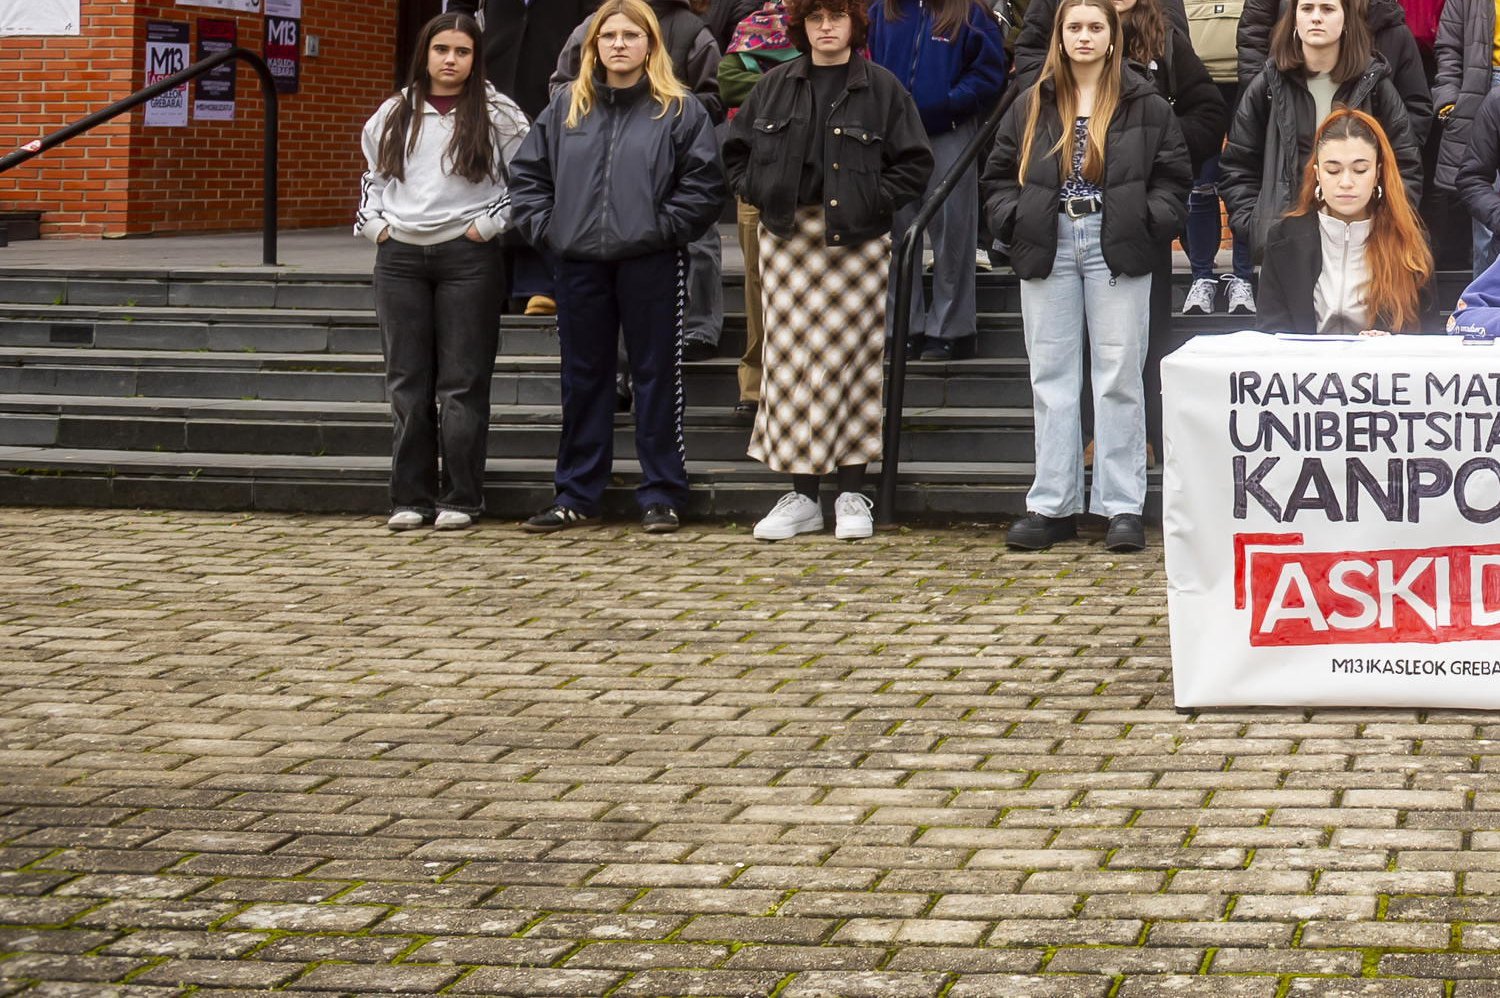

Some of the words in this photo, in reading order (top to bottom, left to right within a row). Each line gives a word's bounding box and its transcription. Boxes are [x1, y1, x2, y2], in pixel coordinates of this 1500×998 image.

[268, 18, 296, 46] M13
[150, 46, 184, 75] M13
[1230, 371, 1411, 406] IRAKASLE
[1259, 555, 1451, 634] ASKI
[1331, 658, 1364, 674] M13
[1366, 659, 1447, 676] IKASLEOK
